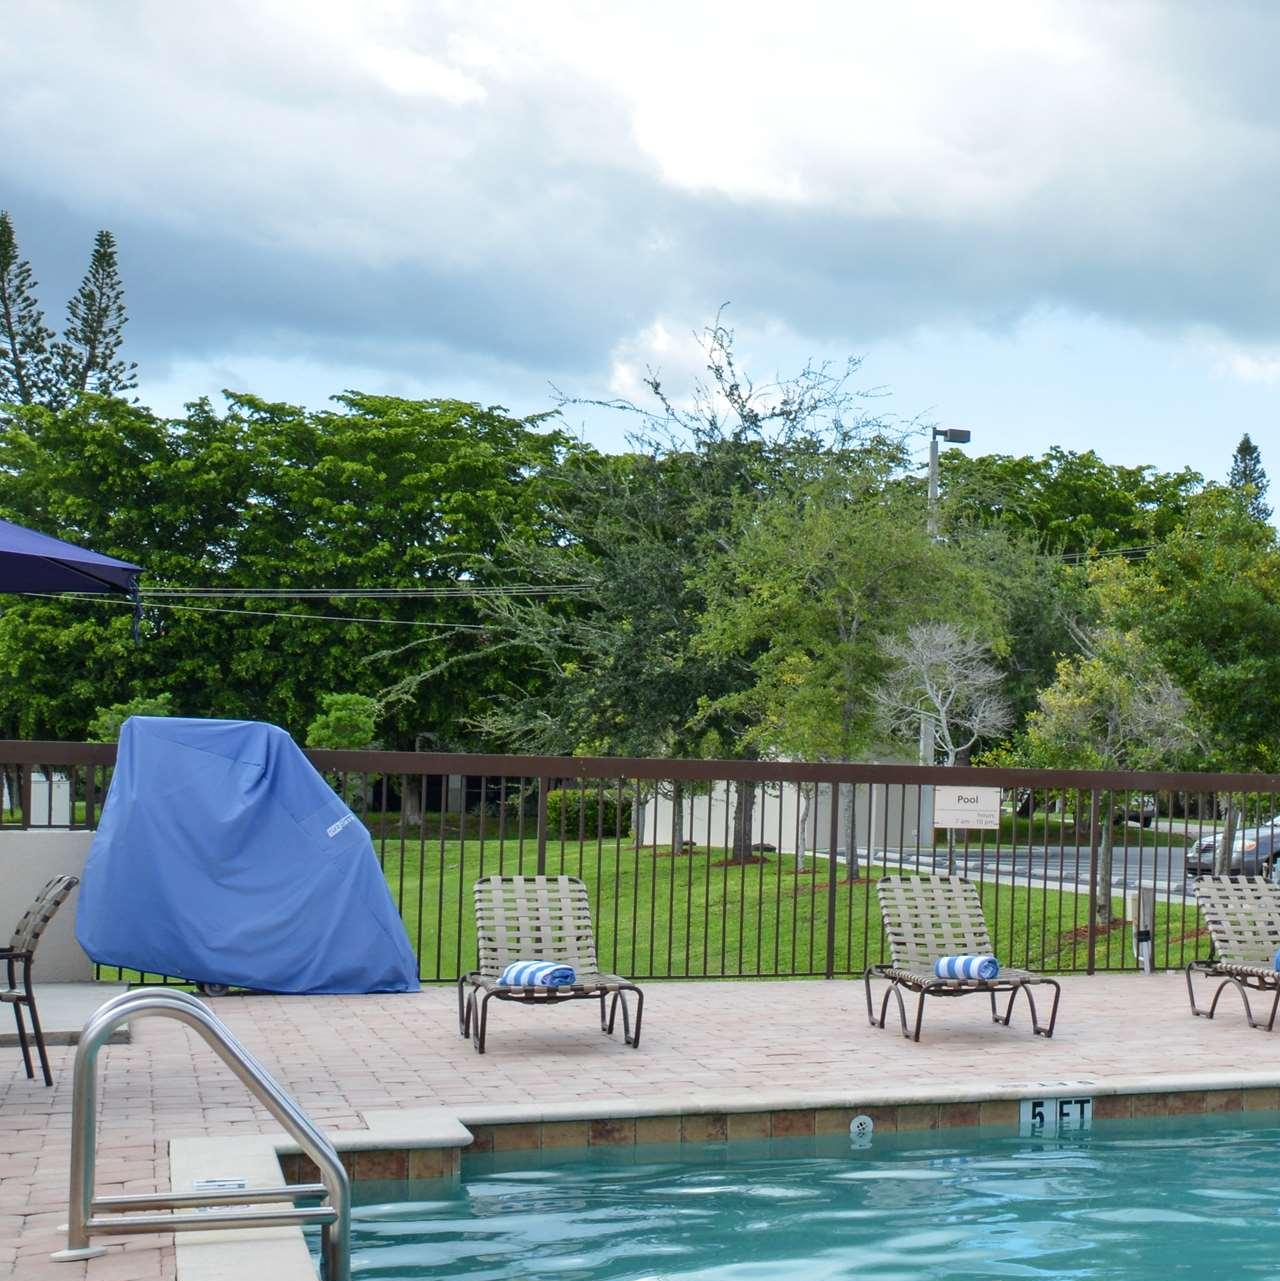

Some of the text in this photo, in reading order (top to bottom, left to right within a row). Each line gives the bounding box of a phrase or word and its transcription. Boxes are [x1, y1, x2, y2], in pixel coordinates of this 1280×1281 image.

[957, 795, 979, 804] Pool
[1031, 1098, 1091, 1127] 5 FT
